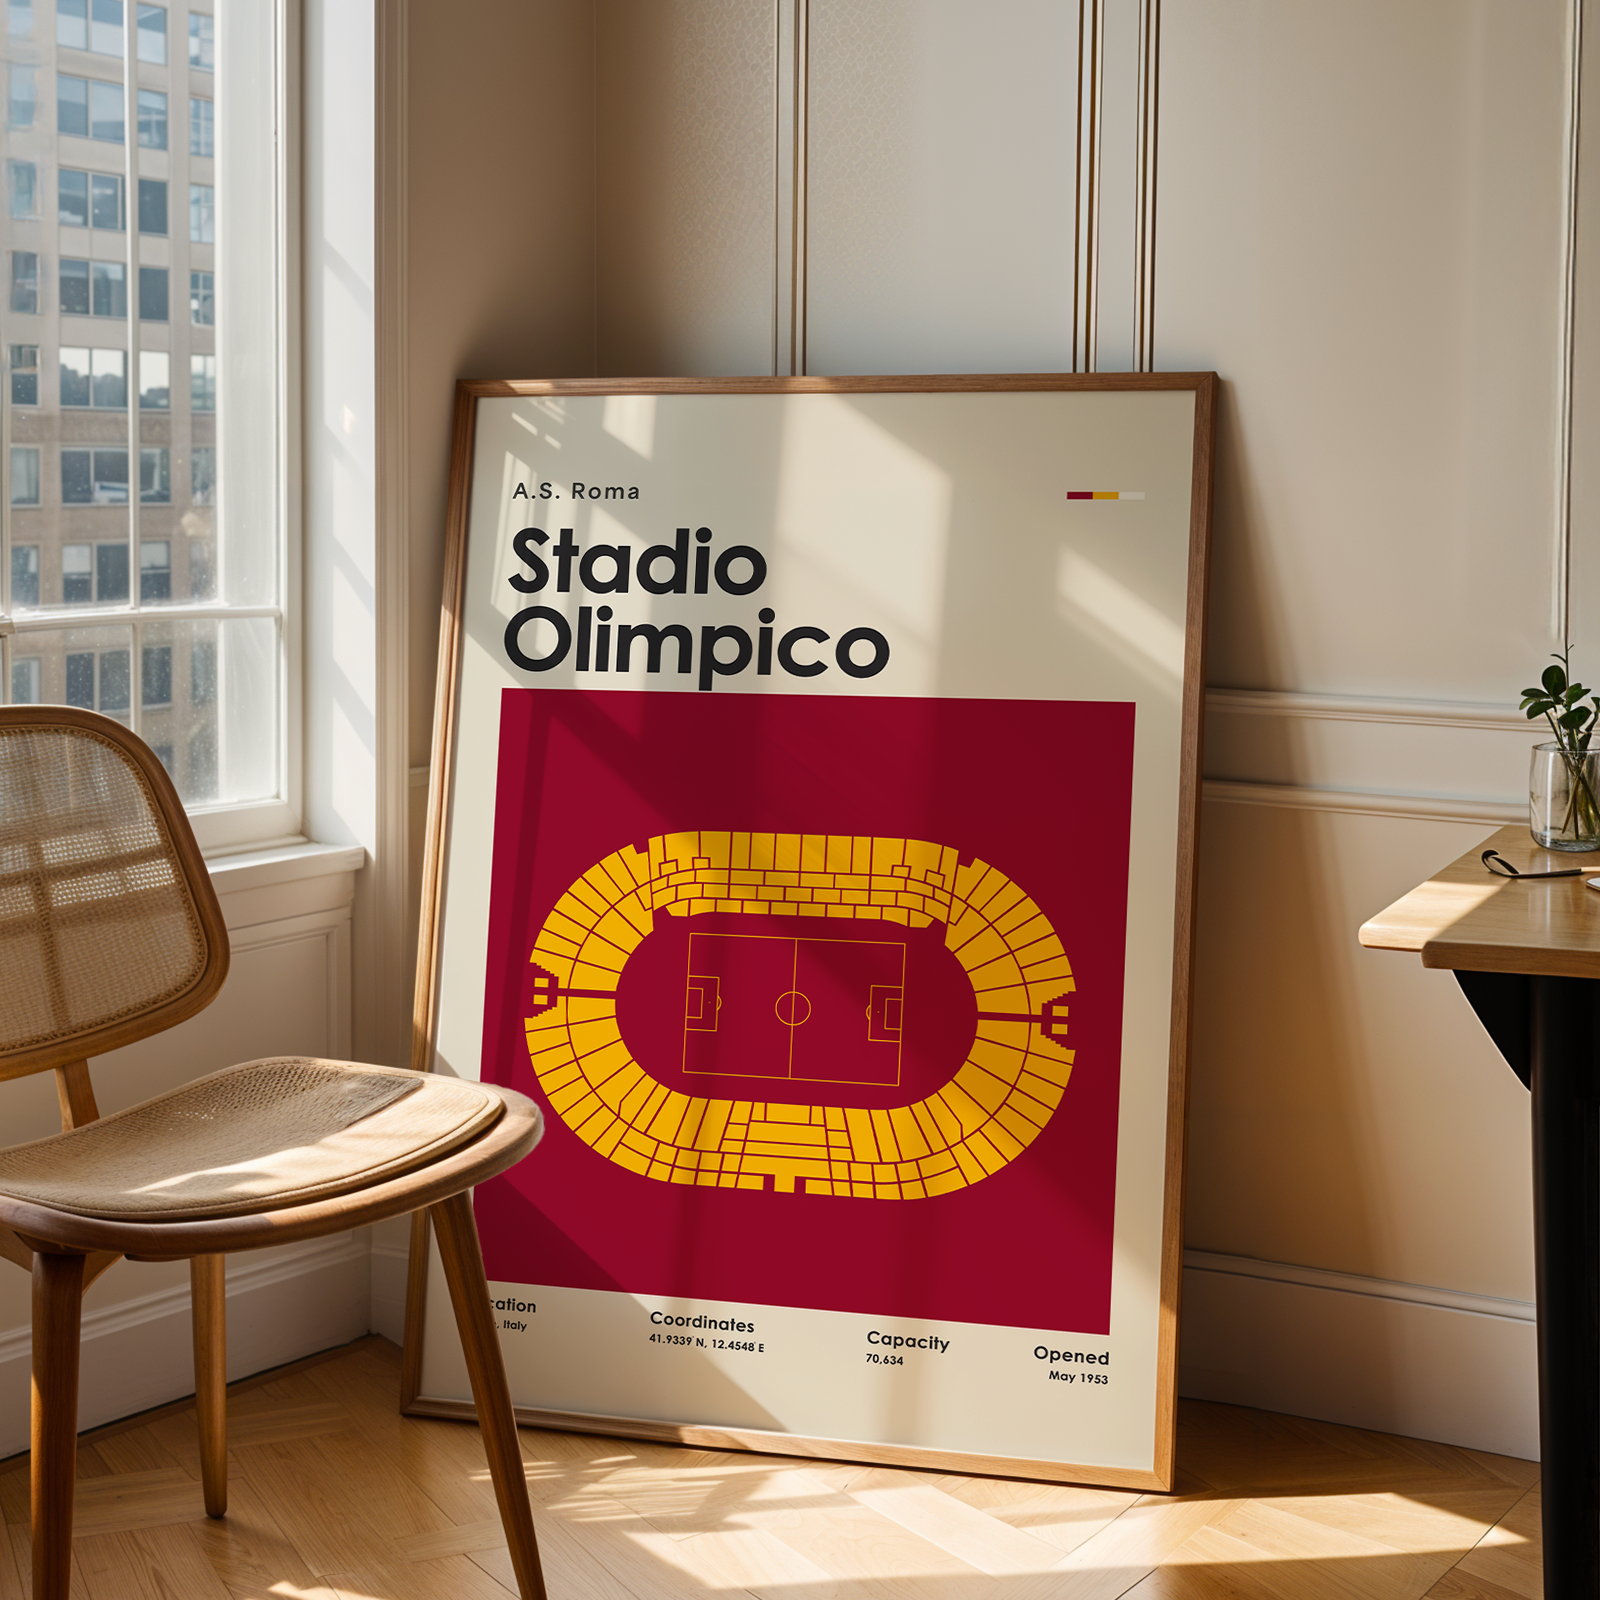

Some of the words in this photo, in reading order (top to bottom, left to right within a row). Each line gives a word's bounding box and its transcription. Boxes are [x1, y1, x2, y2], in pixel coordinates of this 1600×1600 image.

[512, 482, 560, 500] A.S.
[571, 482, 640, 500] Roma
[507, 526, 768, 596] Stadio
[503, 605, 891, 692] Olimpico
[490, 1298, 536, 1313] ation
[503, 1320, 527, 1332] Italy
[650, 1310, 755, 1333] Coordinates
[696, 1337, 708, 1349] N,
[758, 1343, 765, 1353] E
[866, 1330, 950, 1353] Capacity
[865, 1353, 904, 1366] 70,634
[1033, 1345, 1110, 1366] Opened
[1048, 1370, 1076, 1384] May
[1080, 1372, 1109, 1385] 1953
